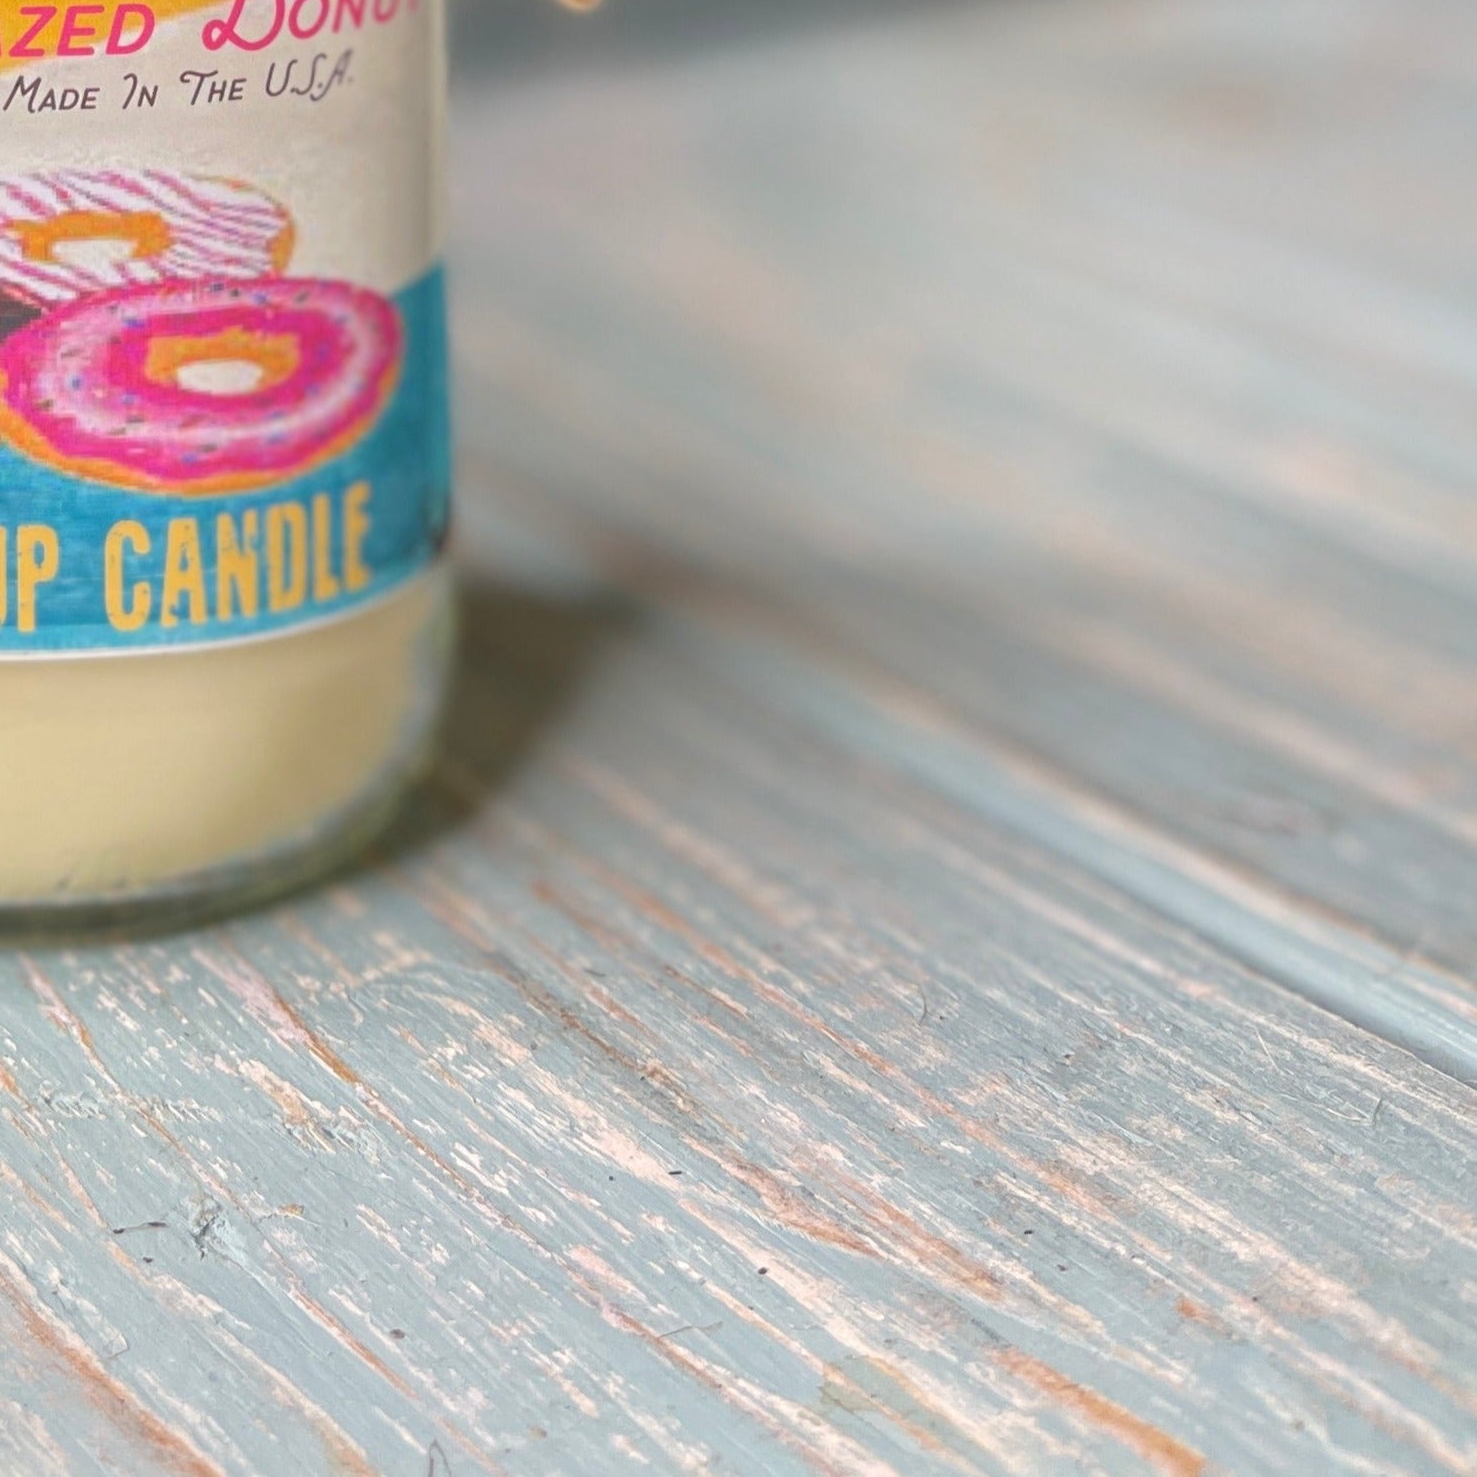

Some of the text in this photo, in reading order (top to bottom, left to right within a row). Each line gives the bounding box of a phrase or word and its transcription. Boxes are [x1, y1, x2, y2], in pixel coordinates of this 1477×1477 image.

[2, 74, 100, 114] MADE
[122, 72, 159, 111] IN
[179, 69, 247, 106] THE
[104, 480, 373, 632] CANDLE
